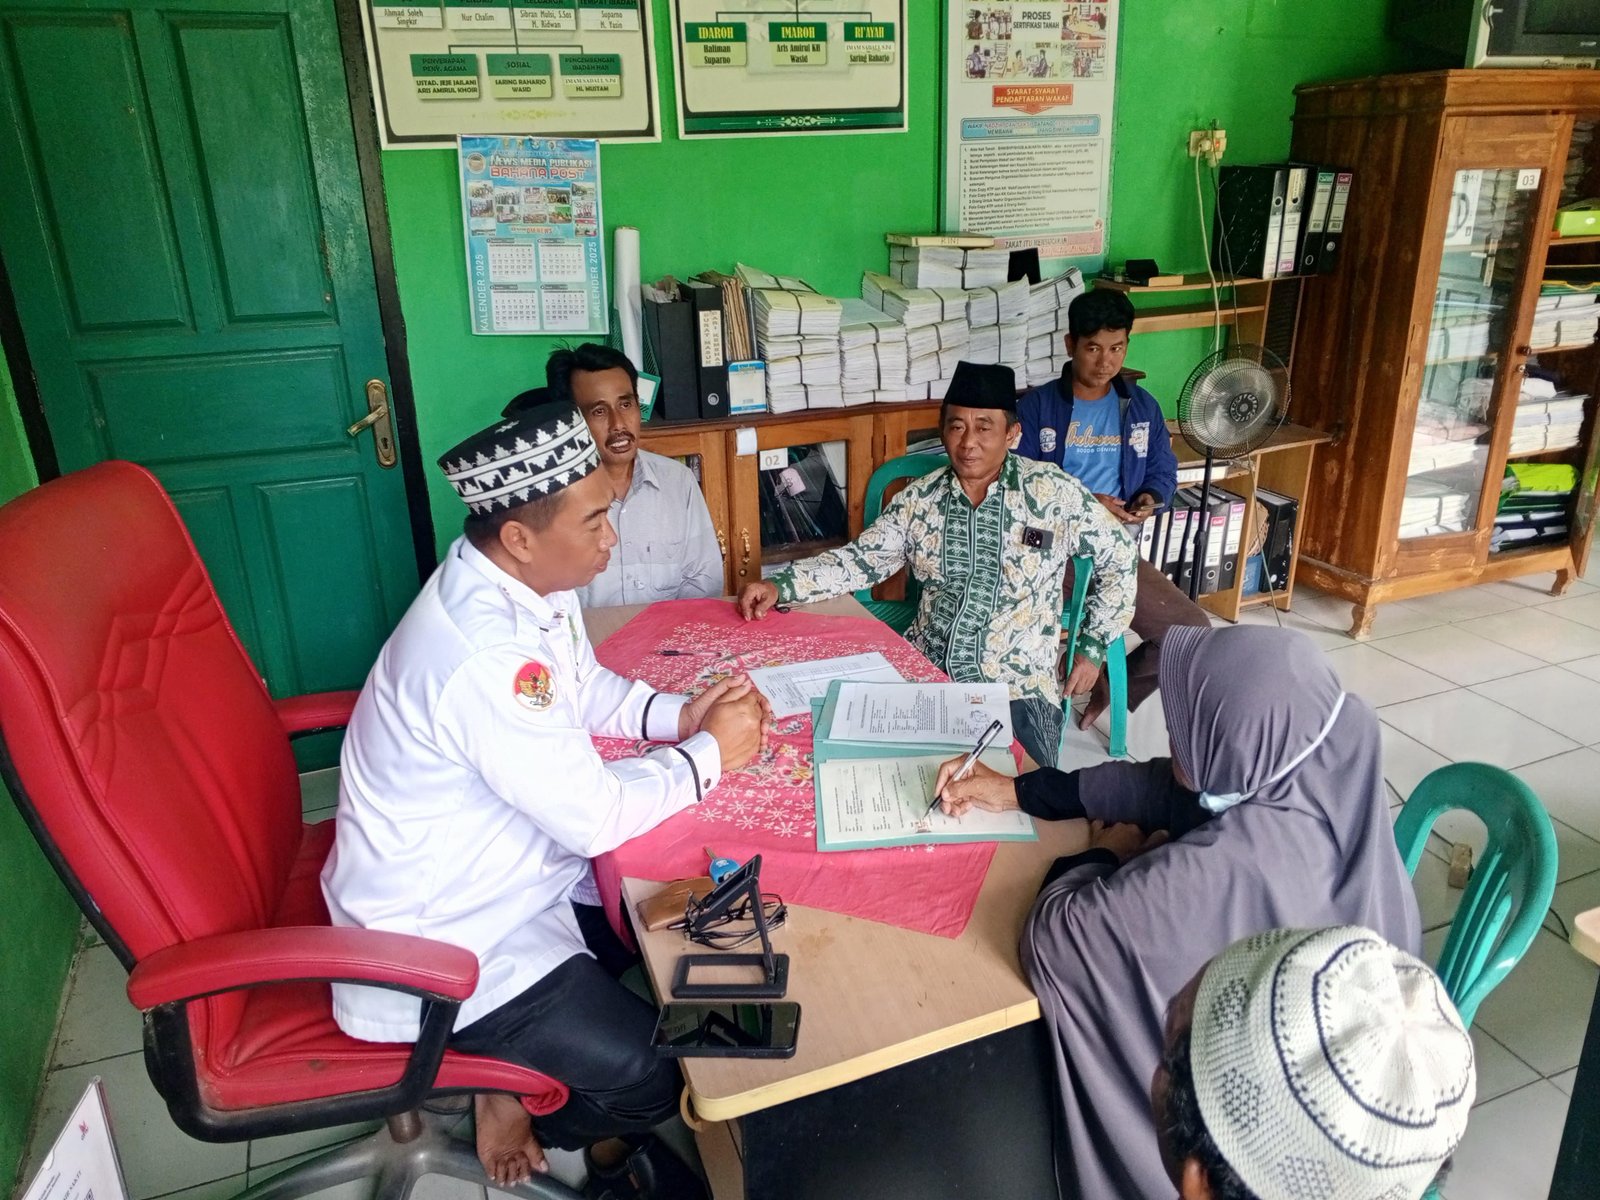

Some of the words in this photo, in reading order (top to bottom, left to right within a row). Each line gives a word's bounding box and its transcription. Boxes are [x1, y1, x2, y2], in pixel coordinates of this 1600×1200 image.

[384, 8, 404, 17] Ahmad
[407, 8, 424, 17] Soleh
[461, 13, 472, 21] Nur
[475, 13, 494, 22] Chalim
[601, 10, 623, 19] Suparno
[1022, 11, 1051, 20] PROSES
[541, 20, 561, 29] Ridwan
[609, 21, 623, 29] Yasin
[698, 26, 734, 39] IDAROH
[781, 26, 815, 39] IMAROH
[854, 26, 885, 39] RI'AYAH
[776, 44, 789, 52] Aris
[789, 44, 810, 52] Amirul
[507, 61, 531, 69] SOSIAL
[704, 56, 731, 65] Suparno
[995, 95, 1044, 104] PENDAFTARAN
[1045, 94, 1069, 102] WAKAF
[520, 157, 547, 167] MEDIA
[550, 158, 592, 168] PUBLIKASI
[490, 166, 547, 179] BAHANA
[549, 167, 586, 180] POST
[1522, 174, 1536, 186] 03
[1005, 241, 1023, 249] ZAKAT
[588, 241, 598, 264] 2025
[475, 254, 485, 277] 2025
[590, 265, 601, 318] KALENDER
[476, 279, 489, 331] KALENDER
[765, 455, 780, 467] 02
